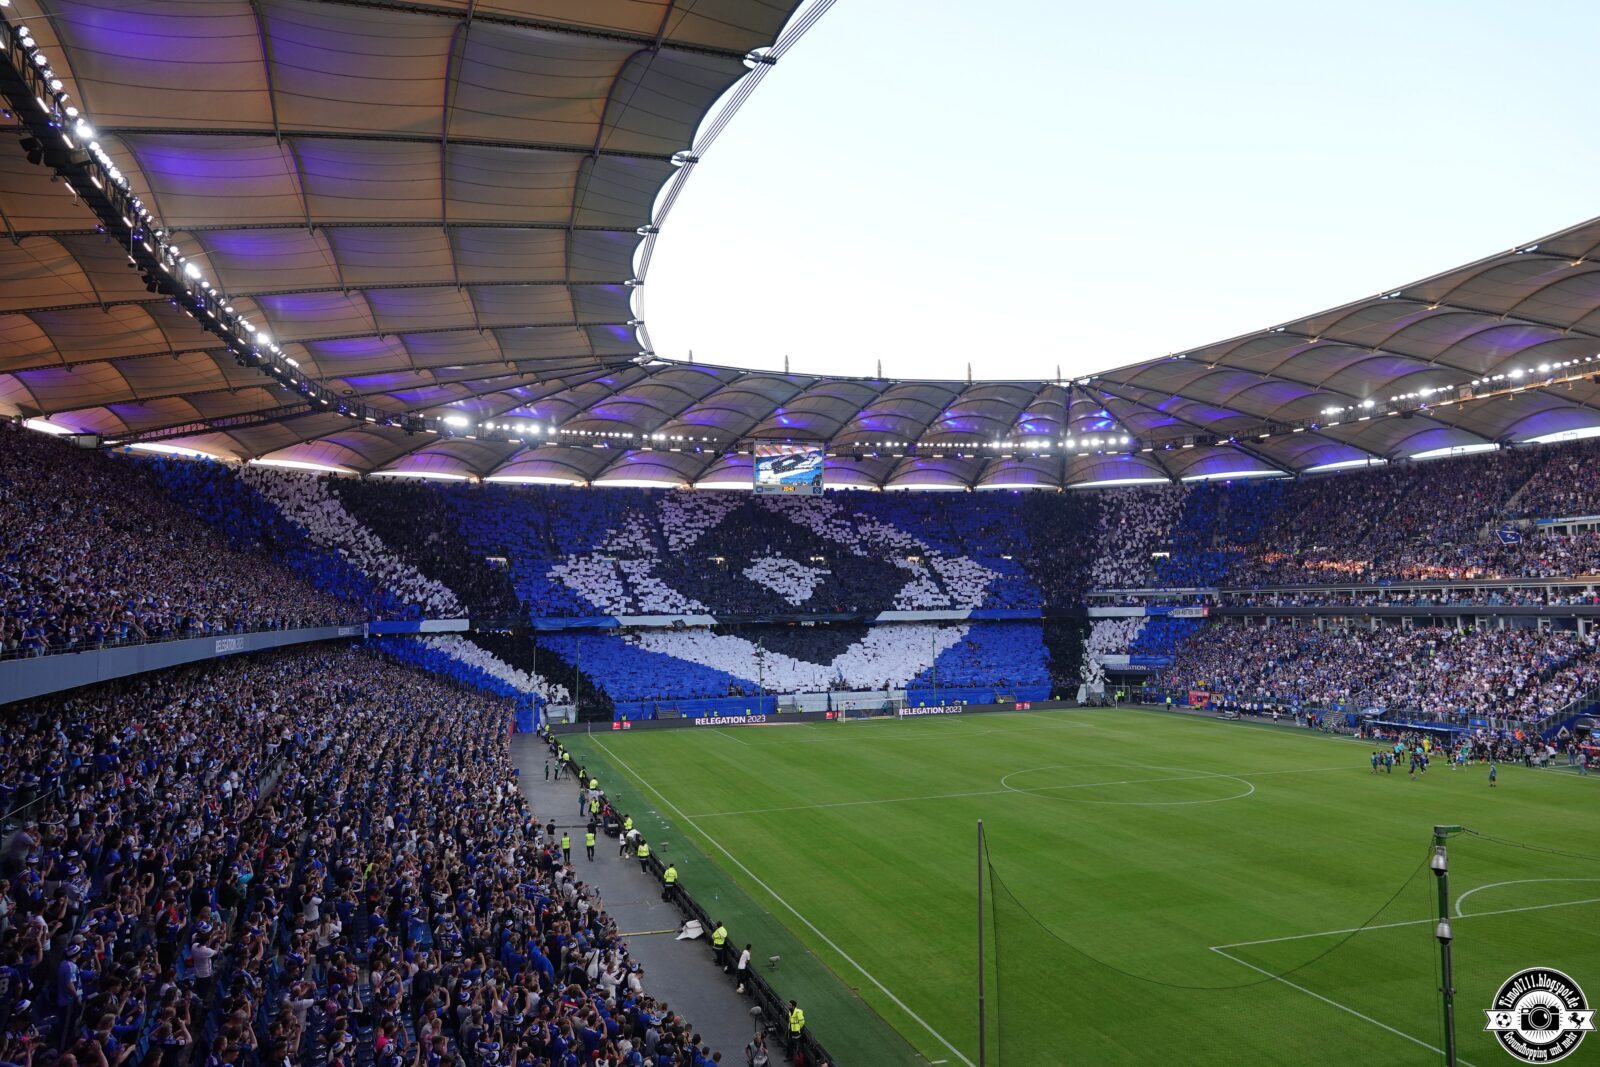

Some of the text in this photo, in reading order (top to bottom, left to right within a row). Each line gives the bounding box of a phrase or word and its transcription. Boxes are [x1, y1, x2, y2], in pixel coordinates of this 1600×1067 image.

[899, 705, 962, 715] RELEGATION 2023
[695, 714, 766, 725] RELEGATION 2023
